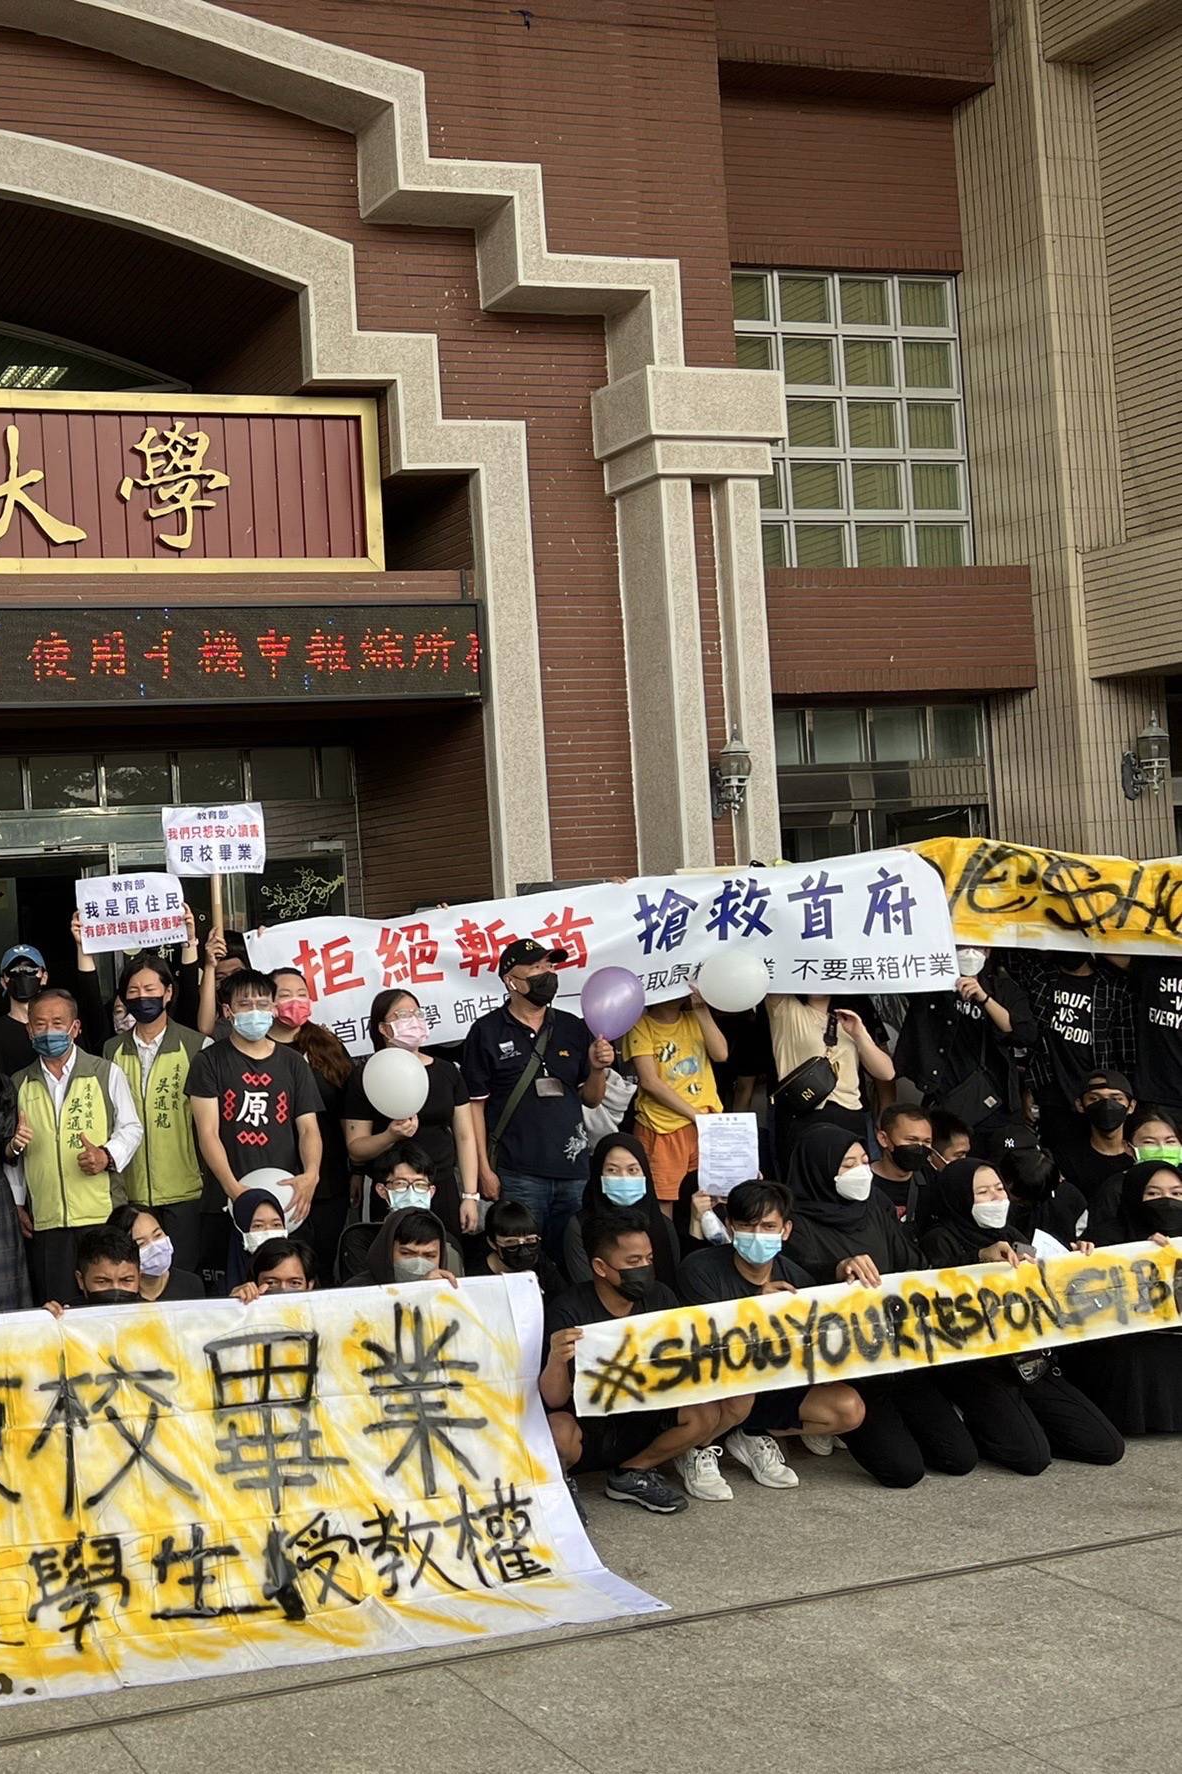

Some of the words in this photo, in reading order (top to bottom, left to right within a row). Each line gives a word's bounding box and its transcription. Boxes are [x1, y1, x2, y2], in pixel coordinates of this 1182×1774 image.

[196, 810, 229, 821] 教育部
[168, 824, 259, 841] 我們只想安心讀書
[180, 843, 252, 863] 原校畢業
[112, 879, 146, 893] 教育部
[84, 892, 180, 919] 我是原住民
[633, 867, 916, 955] 搶救首府
[791, 953, 955, 982] 不要黑箱作業
[154, 1077, 170, 1129] 吳通龍
[236, 1090, 269, 1127] 原
[67, 1098, 83, 1149] 吳通龍
